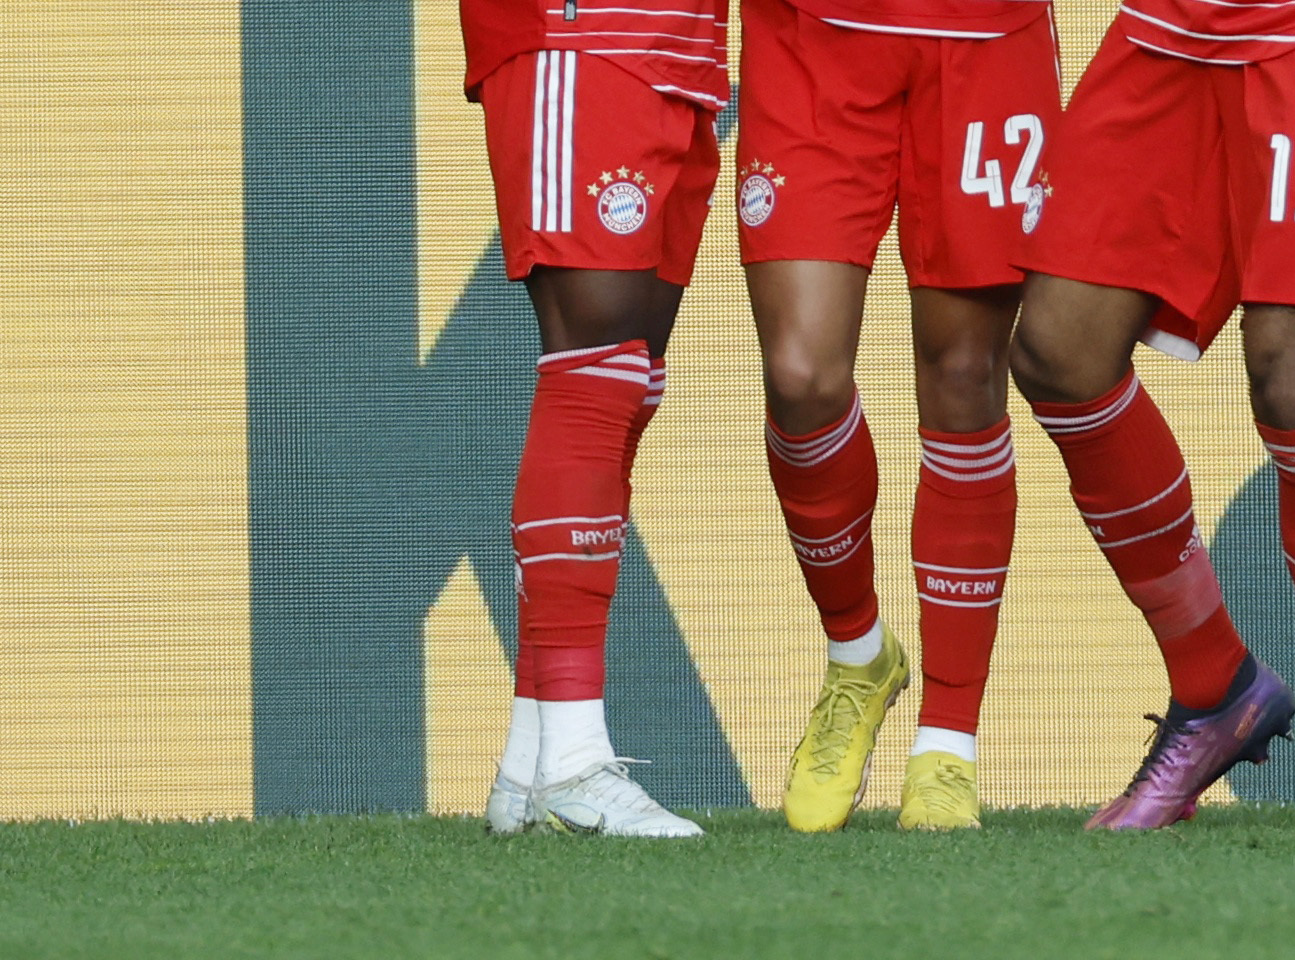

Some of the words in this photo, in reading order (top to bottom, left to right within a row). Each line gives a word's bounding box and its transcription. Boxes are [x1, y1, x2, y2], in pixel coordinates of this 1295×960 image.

[960, 113, 1045, 208] 42
[611, 185, 643, 205] BAYERN
[926, 575, 997, 595] BAYERN
